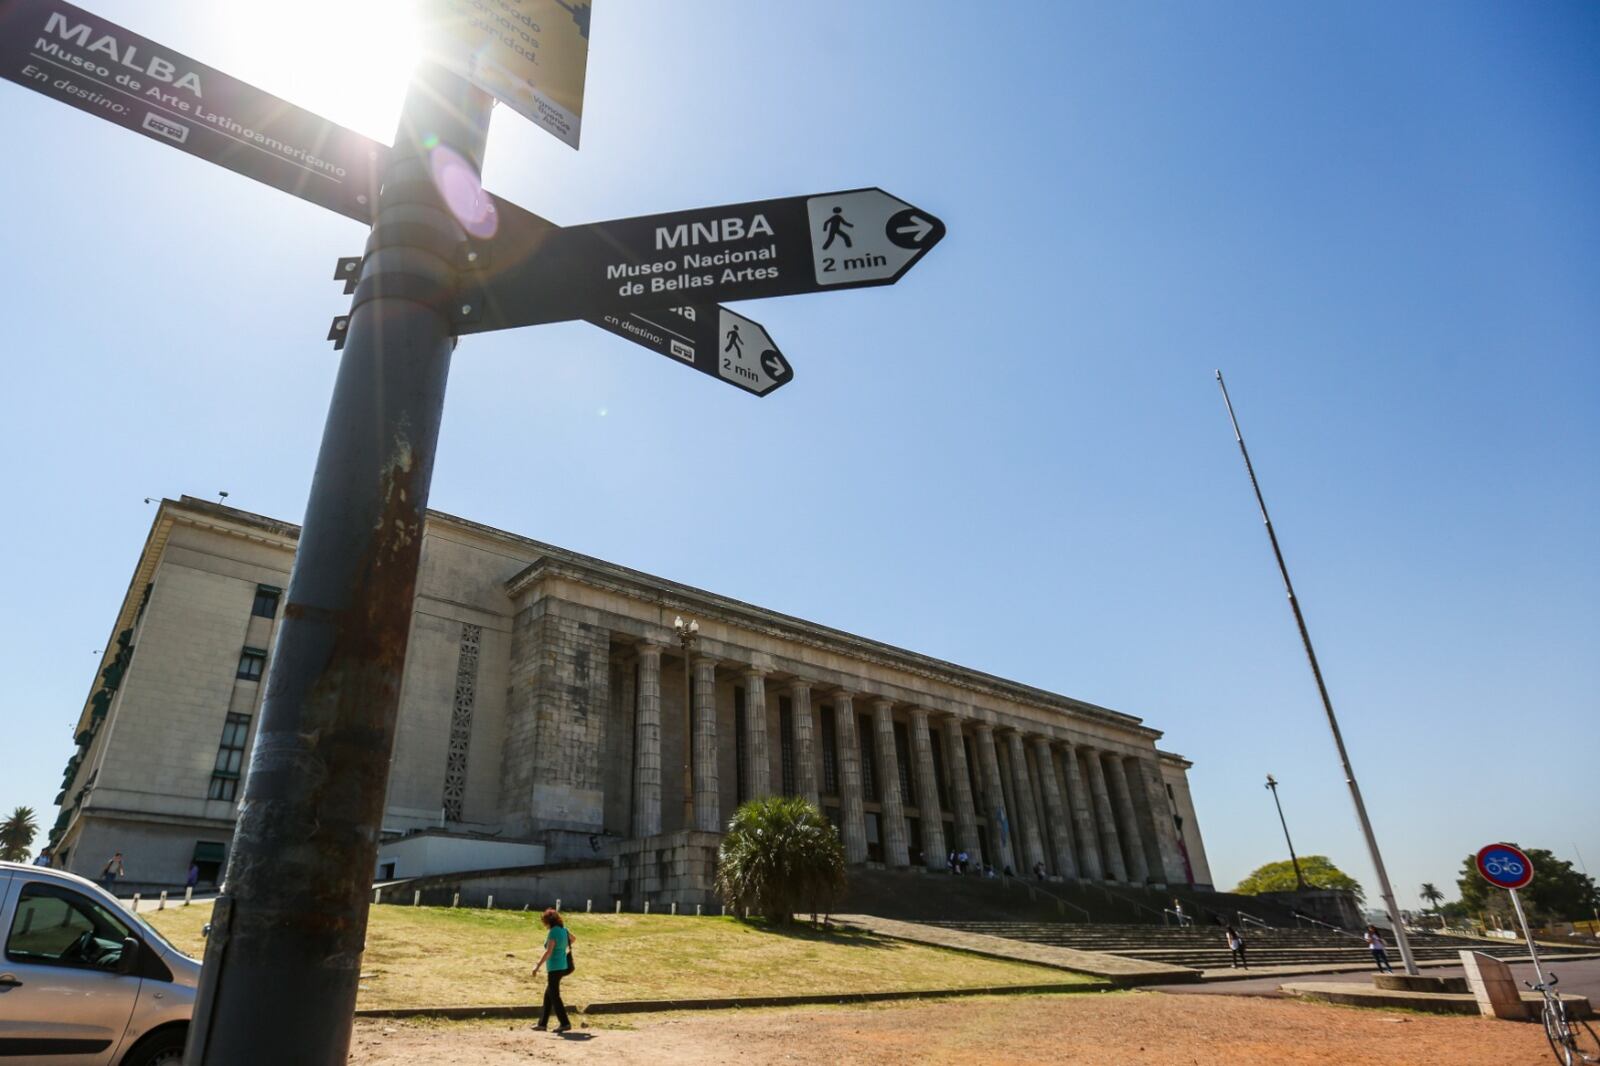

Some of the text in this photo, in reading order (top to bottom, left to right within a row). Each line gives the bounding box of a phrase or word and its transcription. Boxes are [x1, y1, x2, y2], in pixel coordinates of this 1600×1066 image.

[499, 1, 541, 33] eado
[44, 12, 203, 98] MALBA
[21, 64, 130, 116] En destino:
[35, 38, 346, 177] Museo de Arte Latinoamericano
[655, 213, 775, 251] MNBA
[606, 244, 777, 280] Museo Nacional
[822, 252, 888, 273] 2 min
[619, 263, 779, 298] de Bellas Artes
[621, 320, 663, 345] destino:
[723, 358, 759, 383] 2 min
